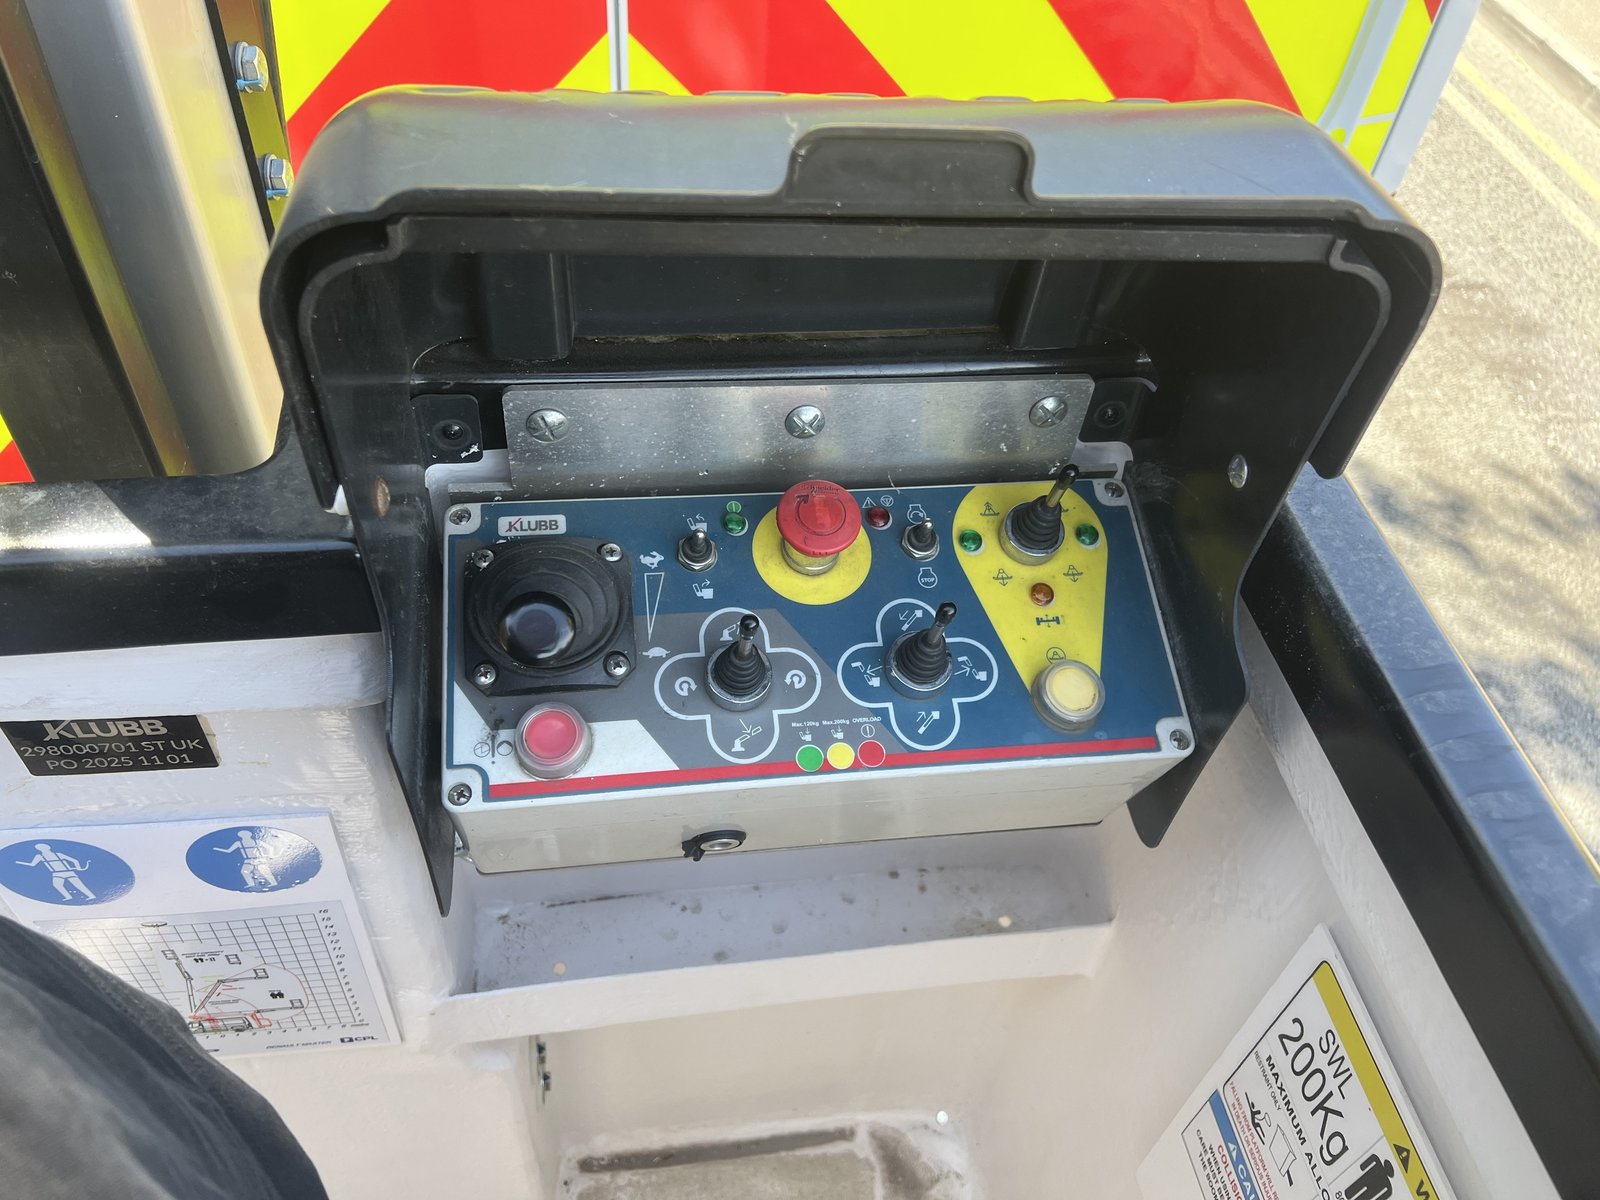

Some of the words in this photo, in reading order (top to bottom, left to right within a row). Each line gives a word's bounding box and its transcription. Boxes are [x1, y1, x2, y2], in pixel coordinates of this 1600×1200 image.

[505, 518, 559, 533] KLUBB
[43, 719, 168, 742] KLUBB
[20, 742, 139, 757] 298000701
[141, 740, 165, 751] ST
[169, 738, 204, 750] UK
[46, 759, 78, 770] PO
[82, 757, 133, 769] 2025
[138, 755, 164, 766] 11
[166, 753, 194, 765] 01
[1319, 1029, 1352, 1100] SWL
[1265, 1054, 1307, 1146] MAXIMUM
[1270, 1091, 1281, 1111] ONLY
[1278, 1017, 1349, 1166] 200Kg
[1196, 1128, 1208, 1157] CARE
[1206, 1157, 1220, 1185] MUST
[1234, 1110, 1246, 1136] DEATH
[1243, 1135, 1251, 1148] OR
[1248, 1147, 1264, 1181] SERIOUS
[1241, 1110, 1252, 1134] FROM
[1249, 1132, 1267, 1173] PLATFORM
[1198, 1151, 1208, 1172] THE
[1208, 1144, 1222, 1175] WHEN
